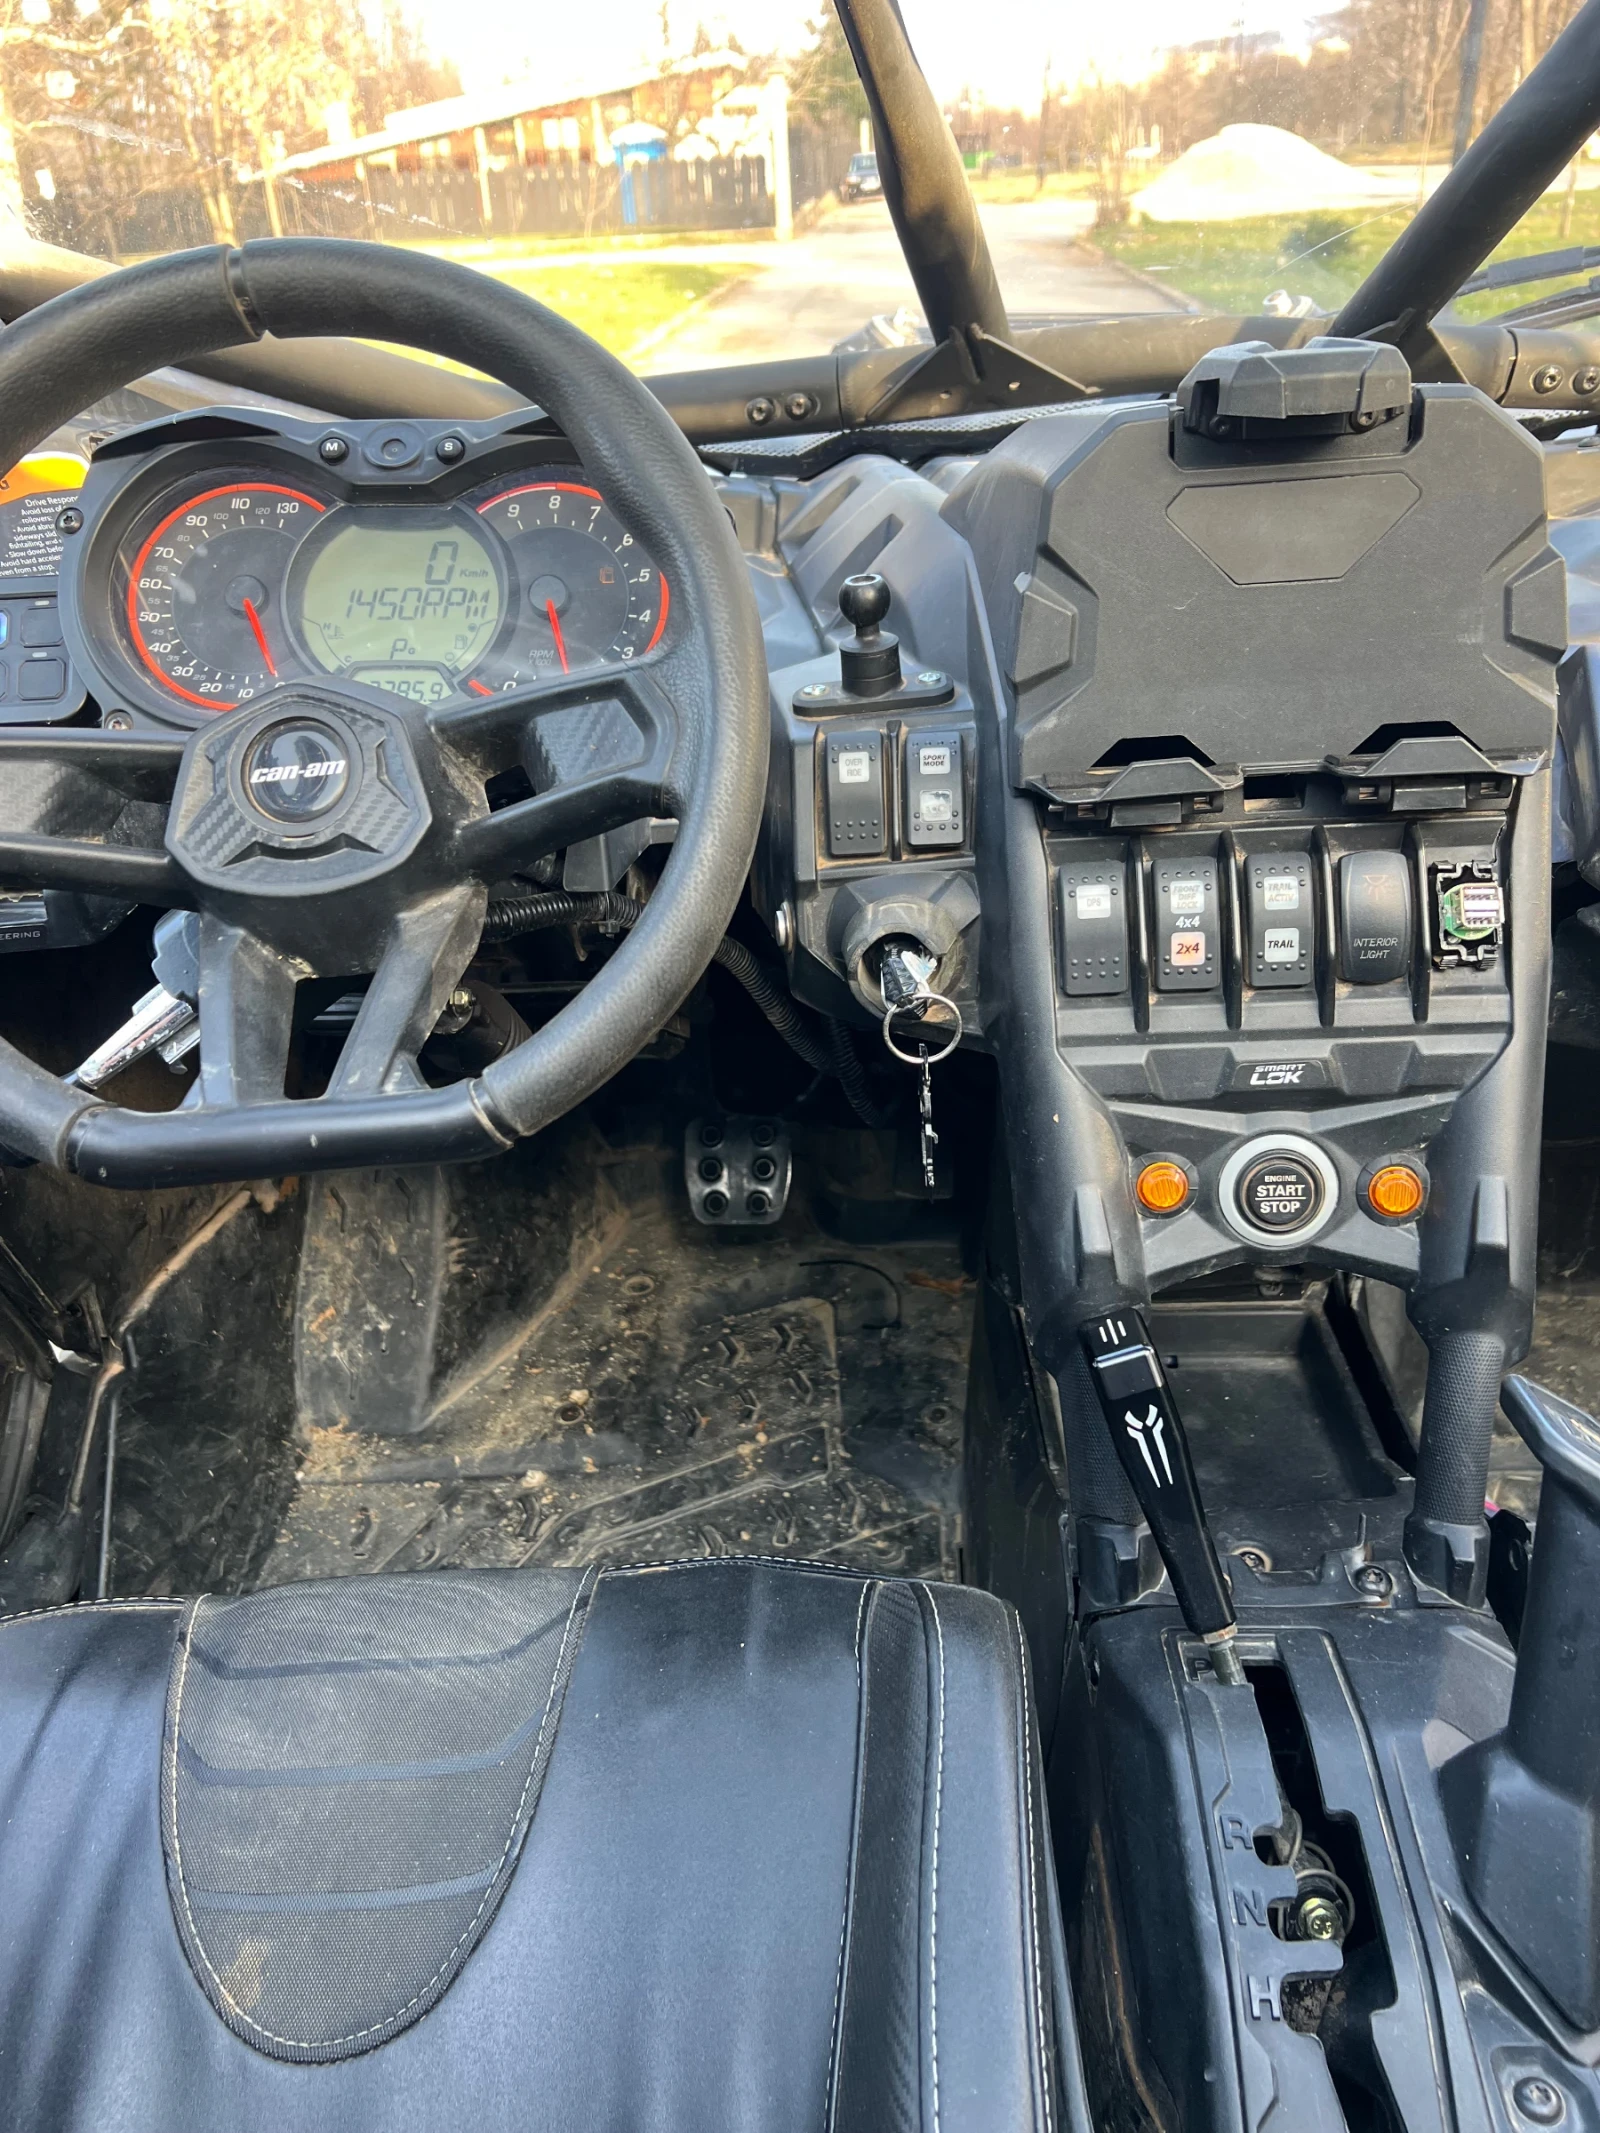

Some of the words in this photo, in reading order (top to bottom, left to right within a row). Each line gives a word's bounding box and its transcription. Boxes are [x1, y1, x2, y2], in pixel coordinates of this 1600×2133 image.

[325, 442, 339, 451] M
[444, 442, 453, 451] S
[25, 499, 47, 507] Drive
[47, 496, 78, 505] Respon
[230, 498, 250, 509] 110
[548, 495, 561, 509] 8
[21, 507, 41, 516] Avoid
[255, 507, 270, 515] 120
[276, 502, 299, 514] 130
[507, 504, 520, 518] 9
[590, 506, 601, 519] 7
[185, 515, 208, 527] 90
[17, 524, 37, 533] Avoid
[13, 533, 45, 542] sideways
[622, 533, 633, 546] 6
[27, 548, 47, 556] down
[154, 547, 174, 558] 70
[0, 559, 20, 567] Avoid
[20, 557, 37, 565] hard
[425, 541, 458, 585] 0
[638, 569, 651, 582] 5
[139, 578, 162, 589] 60
[138, 612, 160, 623] 50
[638, 610, 651, 622] 4
[148, 643, 171, 653] 40
[529, 649, 554, 658] RPM
[621, 647, 634, 659] 3
[171, 666, 194, 677] 30
[199, 682, 222, 692] 20
[237, 688, 254, 698] 10
[250, 760, 346, 783] can-am
[1173, 884, 1200, 894] FRONT
[1268, 882, 1293, 891] TRAIL
[1087, 898, 1101, 907] DPS
[1178, 893, 1196, 901] DIFF
[1268, 893, 1293, 902] ACTIV
[1176, 901, 1198, 909] LOCK
[1175, 915, 1200, 928] 4x4
[1267, 940, 1294, 949] TRAIL
[1353, 937, 1398, 947] INTERIOR
[1176, 942, 1200, 955] 2x4
[1360, 949, 1390, 959] LIGHT
[1254, 1063, 1306, 1073] SMART
[1250, 1070, 1304, 1085] LOK
[1264, 1174, 1297, 1183] ENGINE
[1256, 1184, 1305, 1197] START
[1260, 1201, 1300, 1214] STOP
[1187, 1658, 1212, 1681] P
[1219, 1813, 1253, 1850] R
[1233, 1888, 1266, 1926] N
[1247, 1976, 1281, 2021] H
